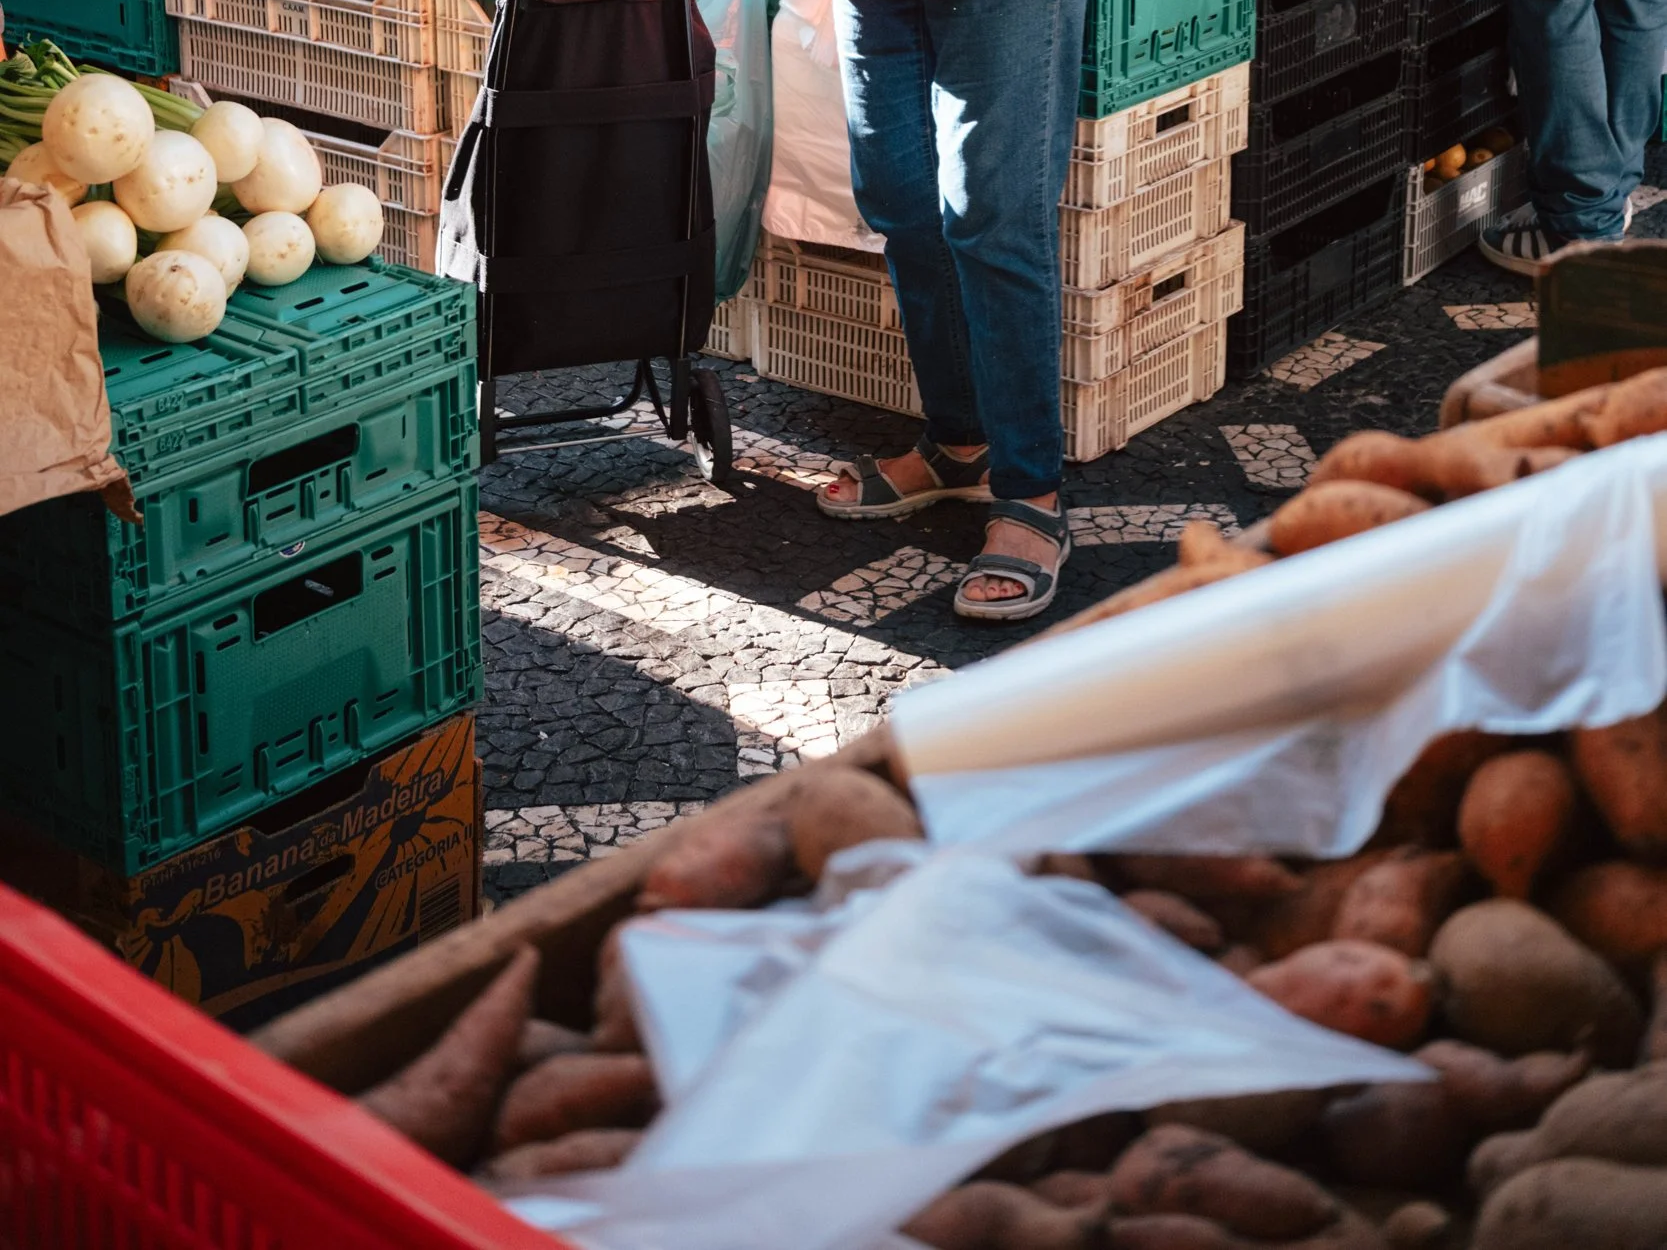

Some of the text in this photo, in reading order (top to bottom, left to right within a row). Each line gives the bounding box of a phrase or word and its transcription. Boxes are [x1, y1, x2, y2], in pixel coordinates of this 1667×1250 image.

[204, 770, 445, 908] Banana da Madeira
[375, 831, 461, 891] CATEGORIA
